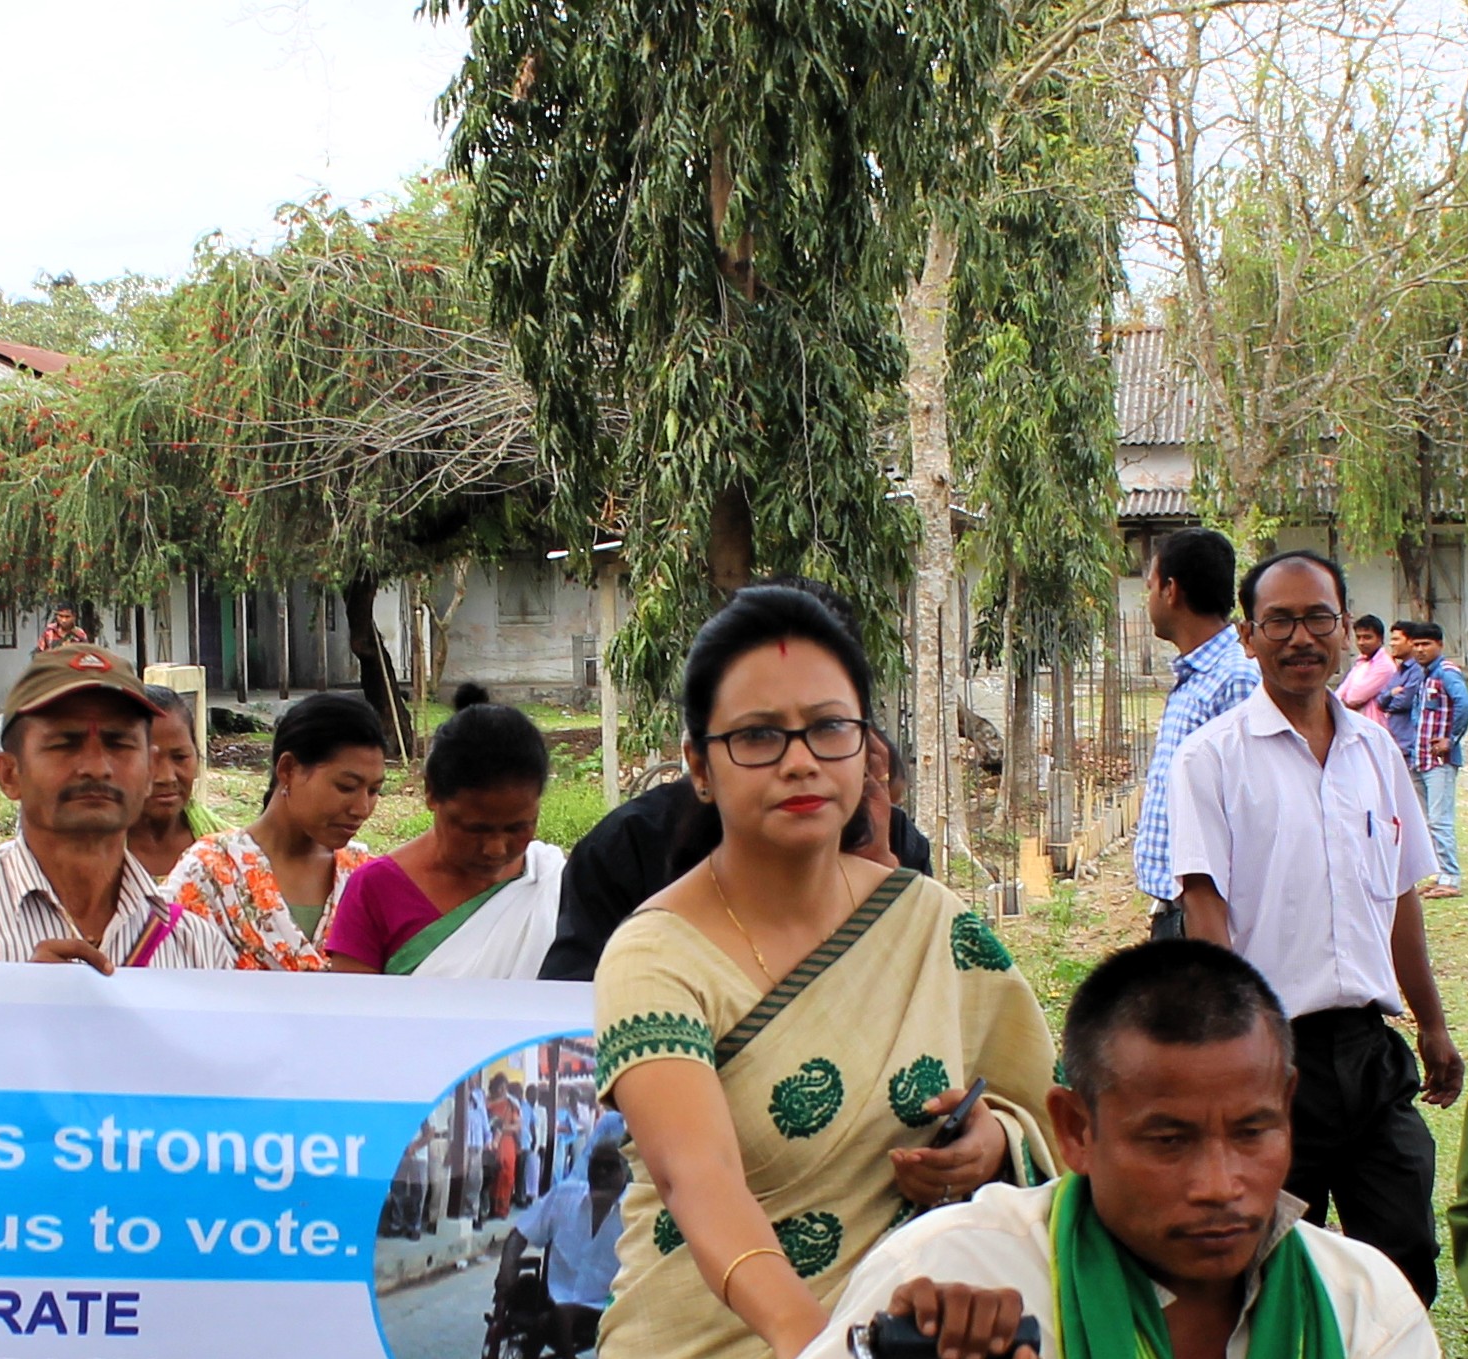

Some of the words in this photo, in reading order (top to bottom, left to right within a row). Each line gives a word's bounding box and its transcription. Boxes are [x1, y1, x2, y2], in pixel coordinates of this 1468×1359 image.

[54, 1114, 365, 1190] stronger
[90, 1206, 160, 1253] to
[187, 1209, 357, 1256] vote.
